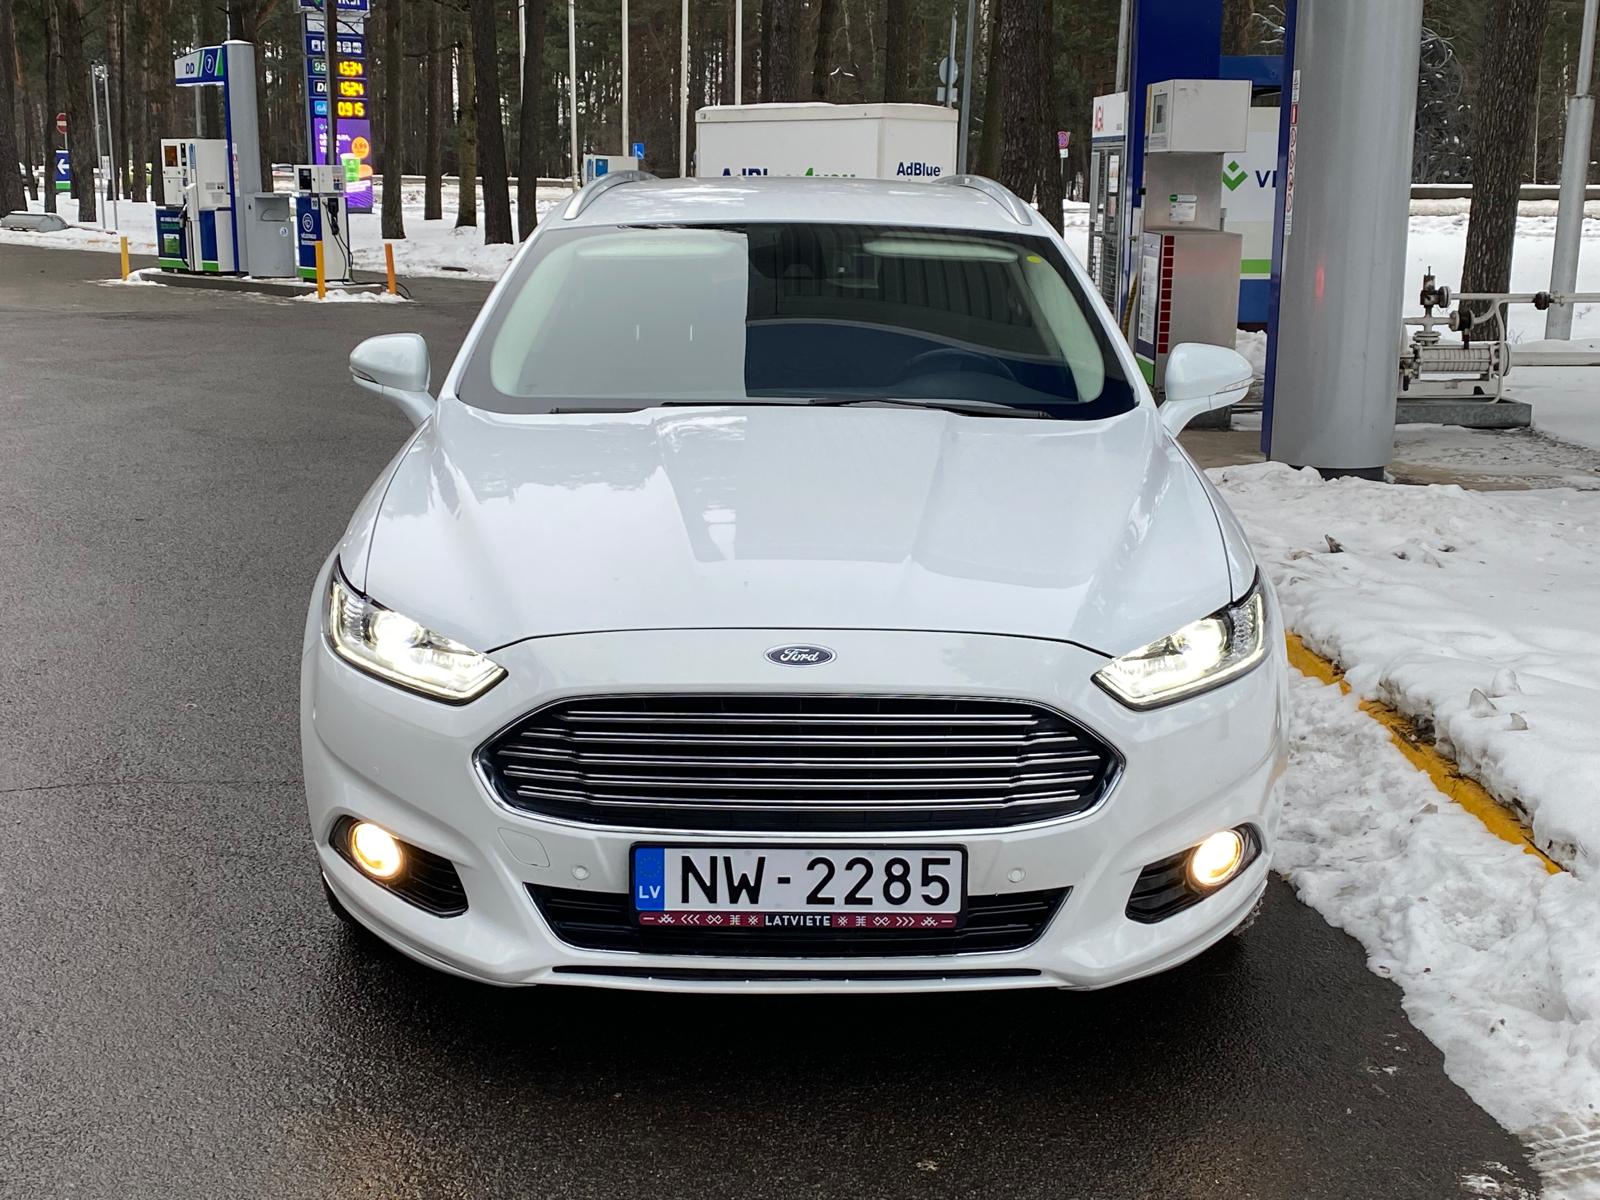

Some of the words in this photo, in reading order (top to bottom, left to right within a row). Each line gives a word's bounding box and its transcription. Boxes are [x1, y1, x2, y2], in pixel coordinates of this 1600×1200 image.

[896, 162, 941, 176] AdBlue
[780, 648, 820, 661] Ford
[638, 885, 661, 899] LV
[765, 915, 831, 926] LATVIETE
